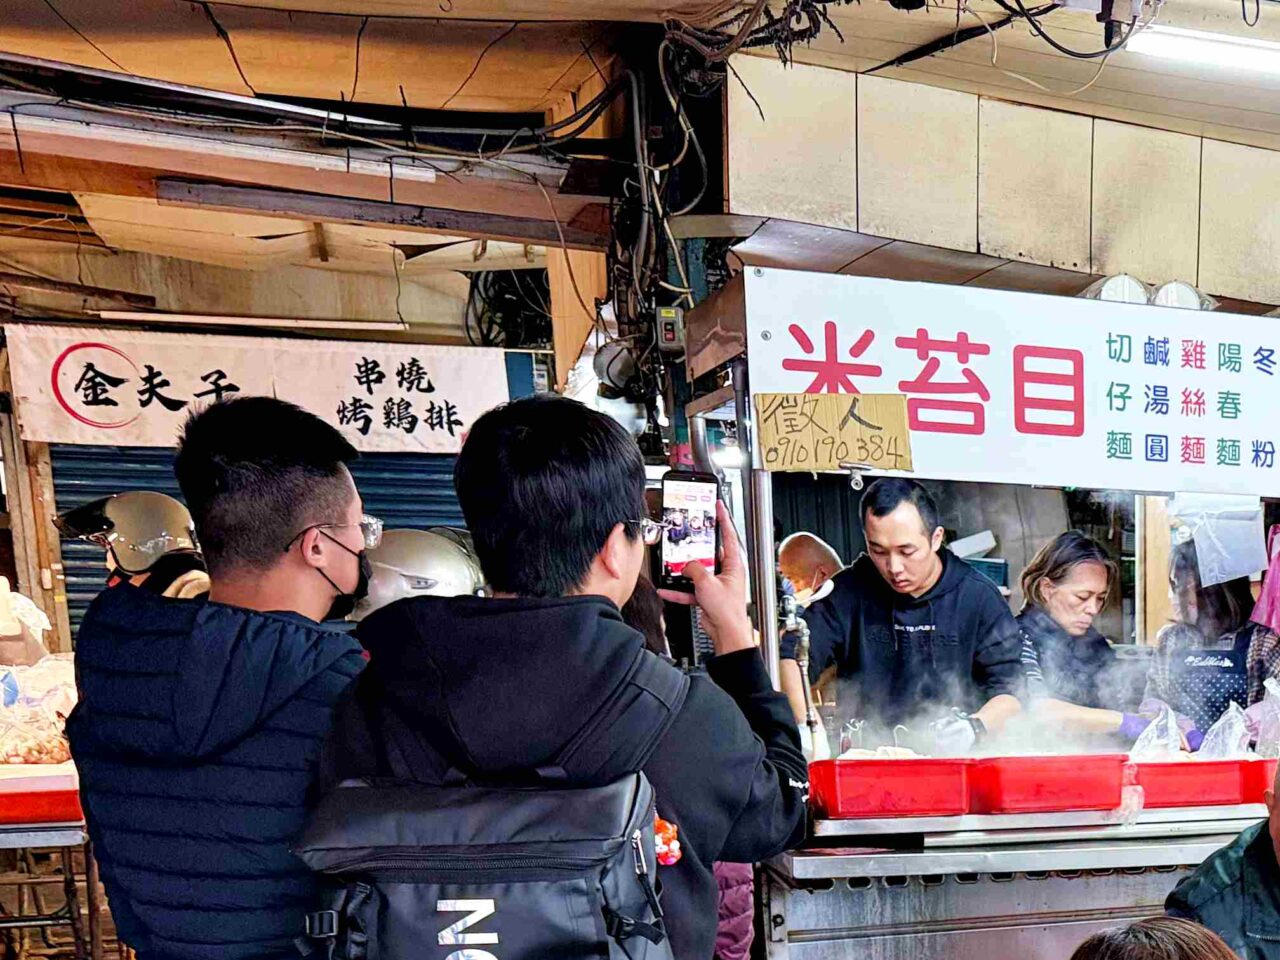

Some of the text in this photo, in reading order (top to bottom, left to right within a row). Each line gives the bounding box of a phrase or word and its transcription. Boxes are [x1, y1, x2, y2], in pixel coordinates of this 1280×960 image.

[73, 361, 241, 410] 金夫子
[353, 356, 435, 395] 串燒
[782, 321, 1084, 437] 米苔目
[1105, 332, 1133, 460] 切仔麵
[1144, 335, 1170, 462] 鹹湯圓
[1181, 339, 1206, 465] 雞絲麵
[1216, 342, 1242, 467] 陽春麵
[1251, 346, 1277, 469] 冬粉
